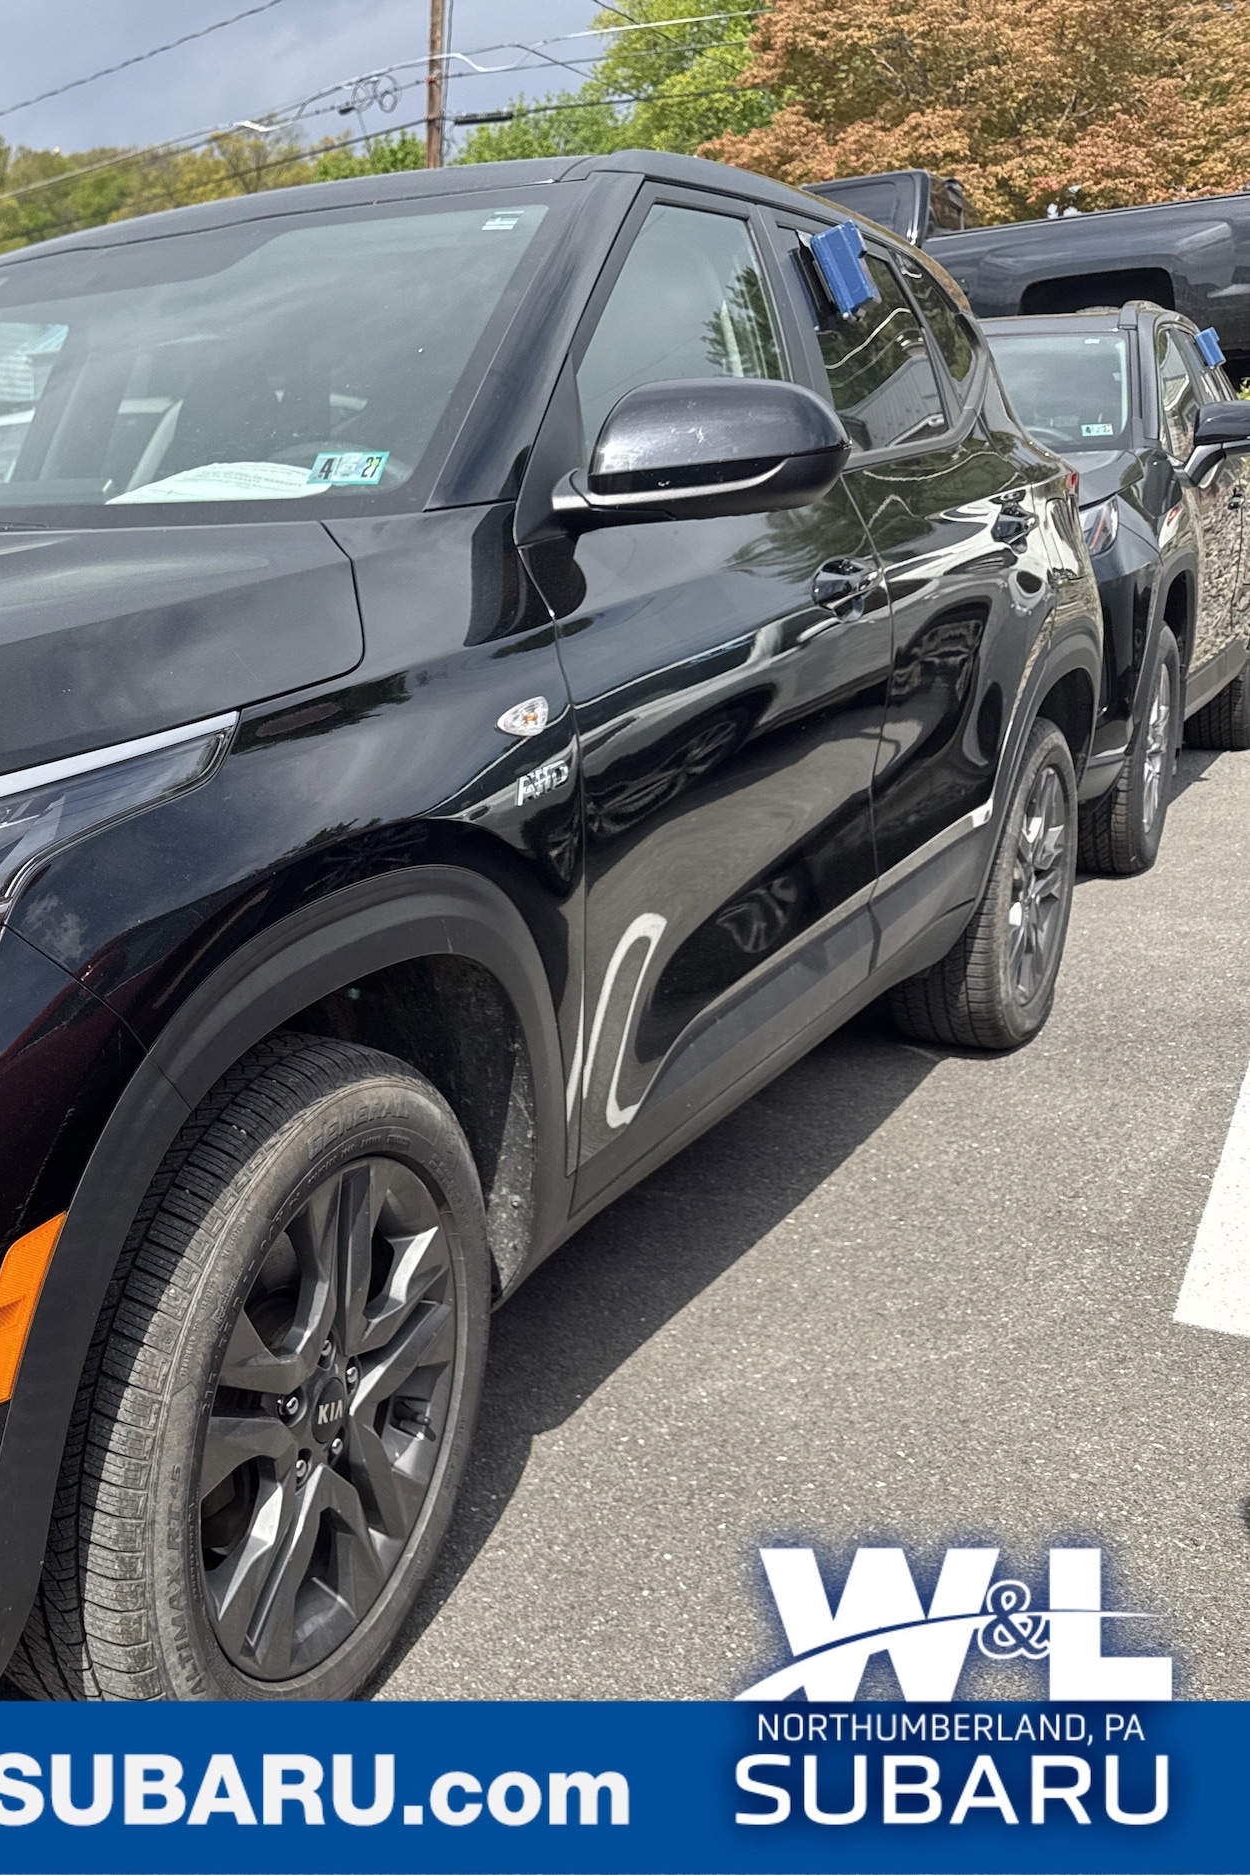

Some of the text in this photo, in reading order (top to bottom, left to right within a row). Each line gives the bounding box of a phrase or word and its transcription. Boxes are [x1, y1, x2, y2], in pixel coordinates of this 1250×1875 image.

[319, 456, 382, 480] 4 27
[515, 760, 569, 807] AWD
[307, 1099, 410, 1161] GENERAL
[317, 1399, 343, 1425] KIA
[165, 1565, 207, 1696] ALTIMAX
